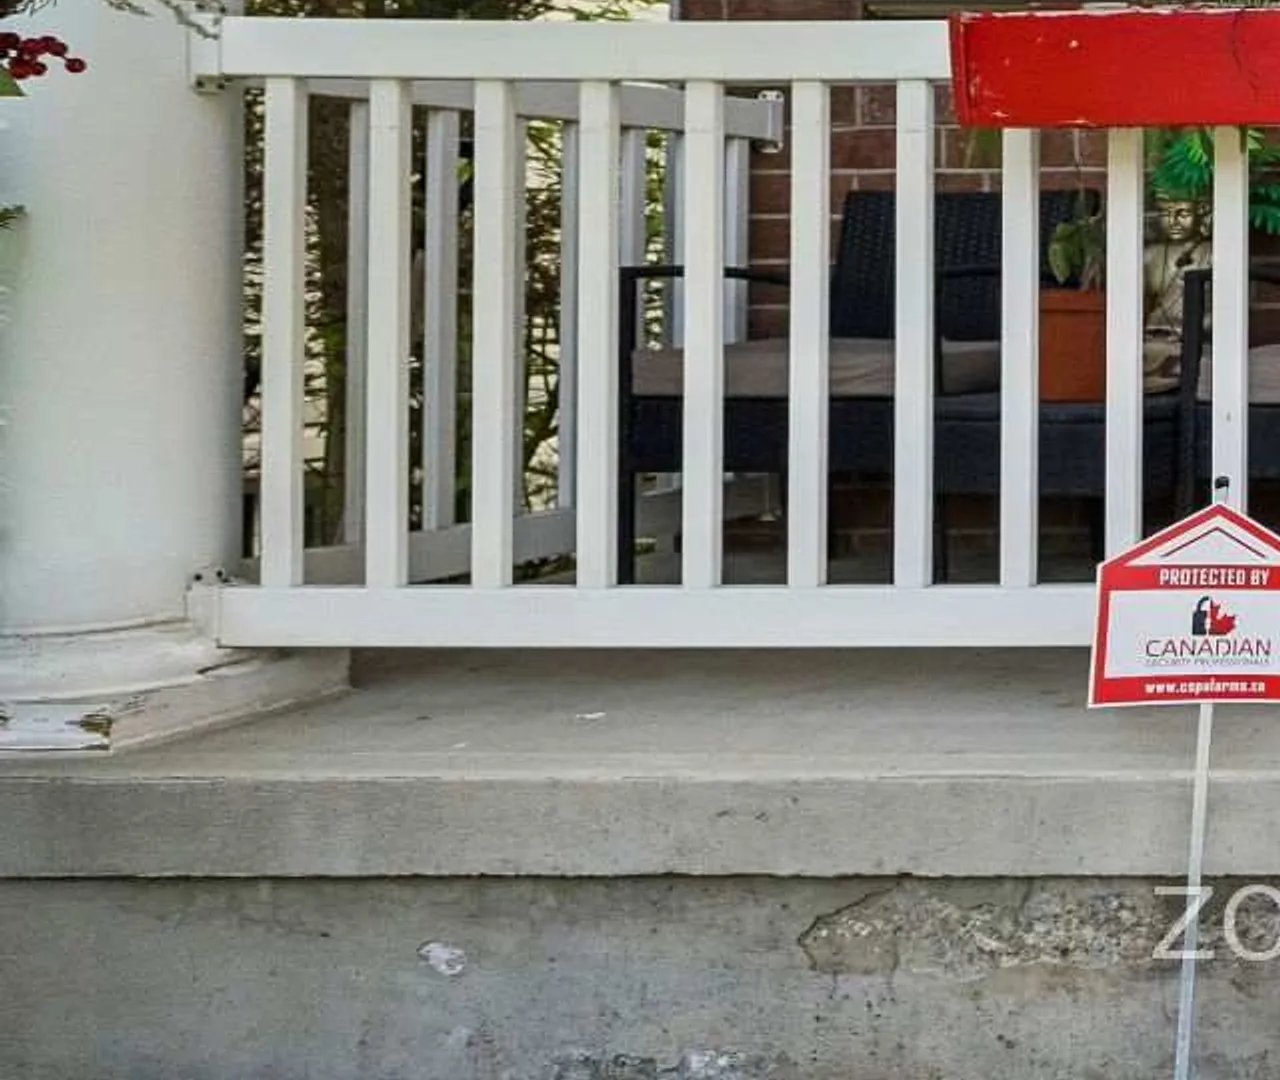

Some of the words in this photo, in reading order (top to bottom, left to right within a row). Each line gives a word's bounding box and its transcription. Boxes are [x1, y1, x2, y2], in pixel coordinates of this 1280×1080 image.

[1159, 568, 1246, 586] PROTECTED
[1250, 568, 1271, 586] BY
[1145, 638, 1272, 657] CANADIAN
